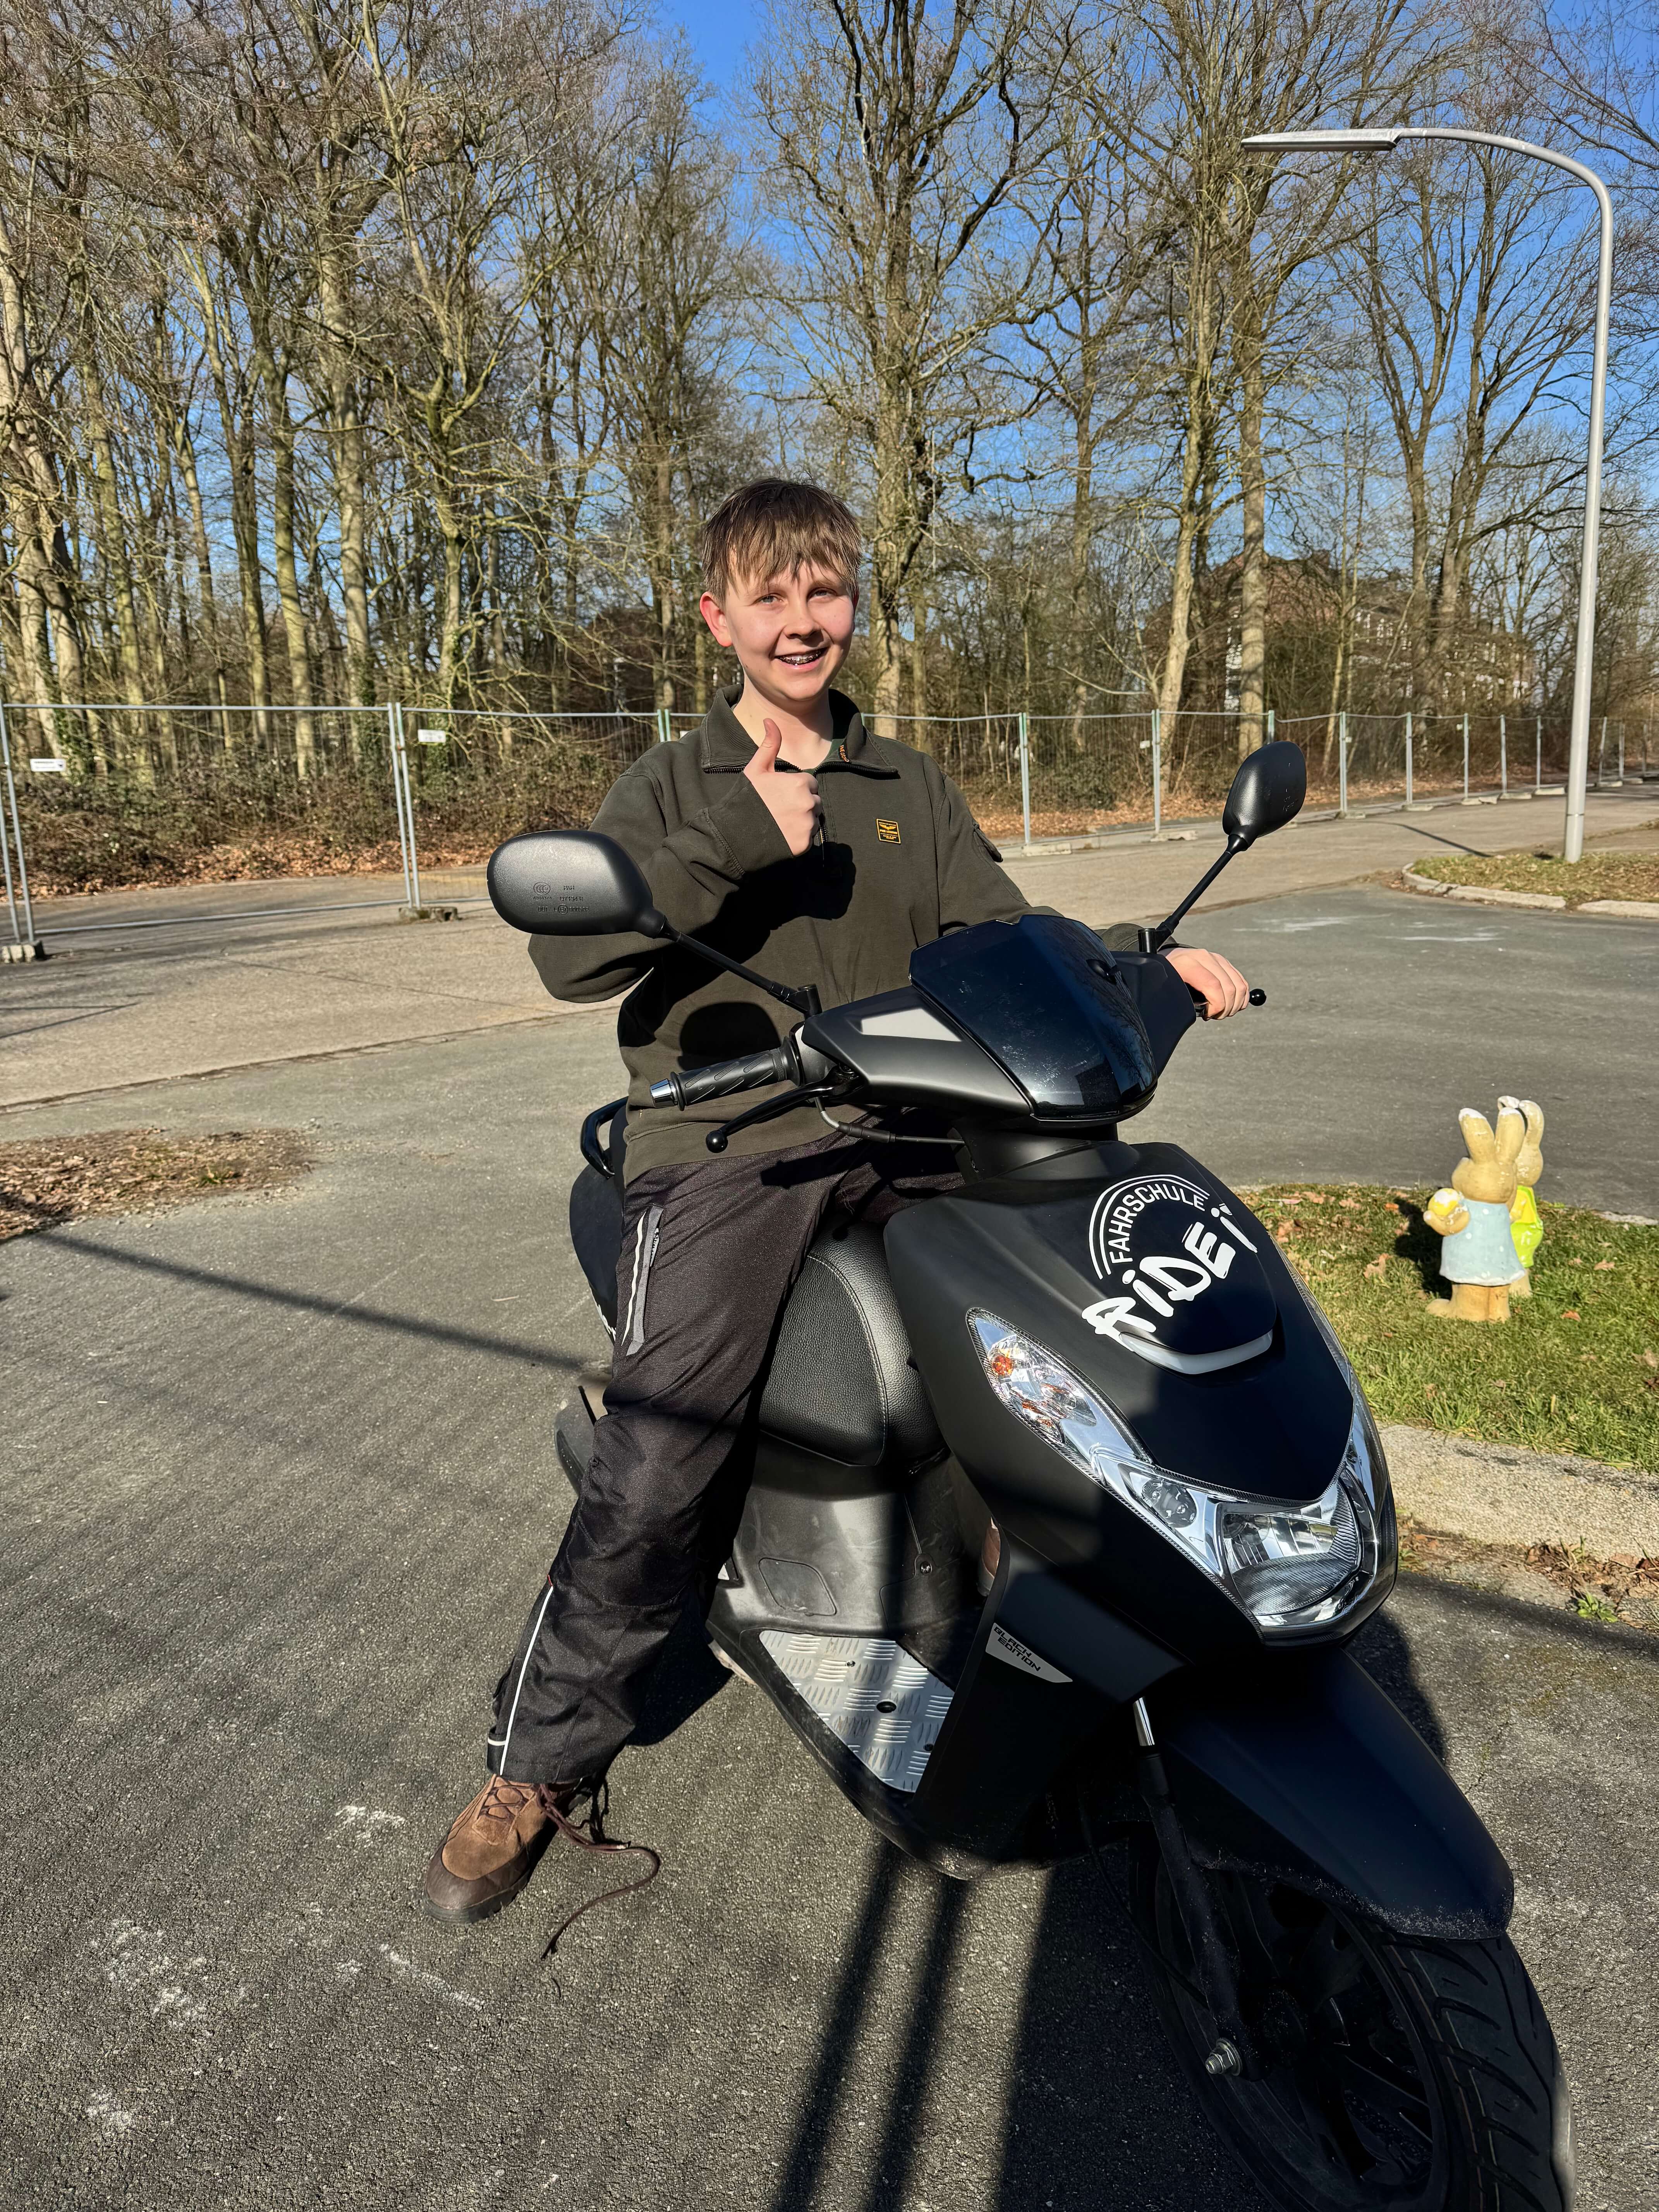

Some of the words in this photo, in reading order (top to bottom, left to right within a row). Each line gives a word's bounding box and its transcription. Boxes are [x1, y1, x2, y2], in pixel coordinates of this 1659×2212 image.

[1108, 1183, 1205, 1264] FAHRSCHULE
[994, 1627, 1032, 1657] BLACK
[998, 1637, 1041, 1671] EDITION
